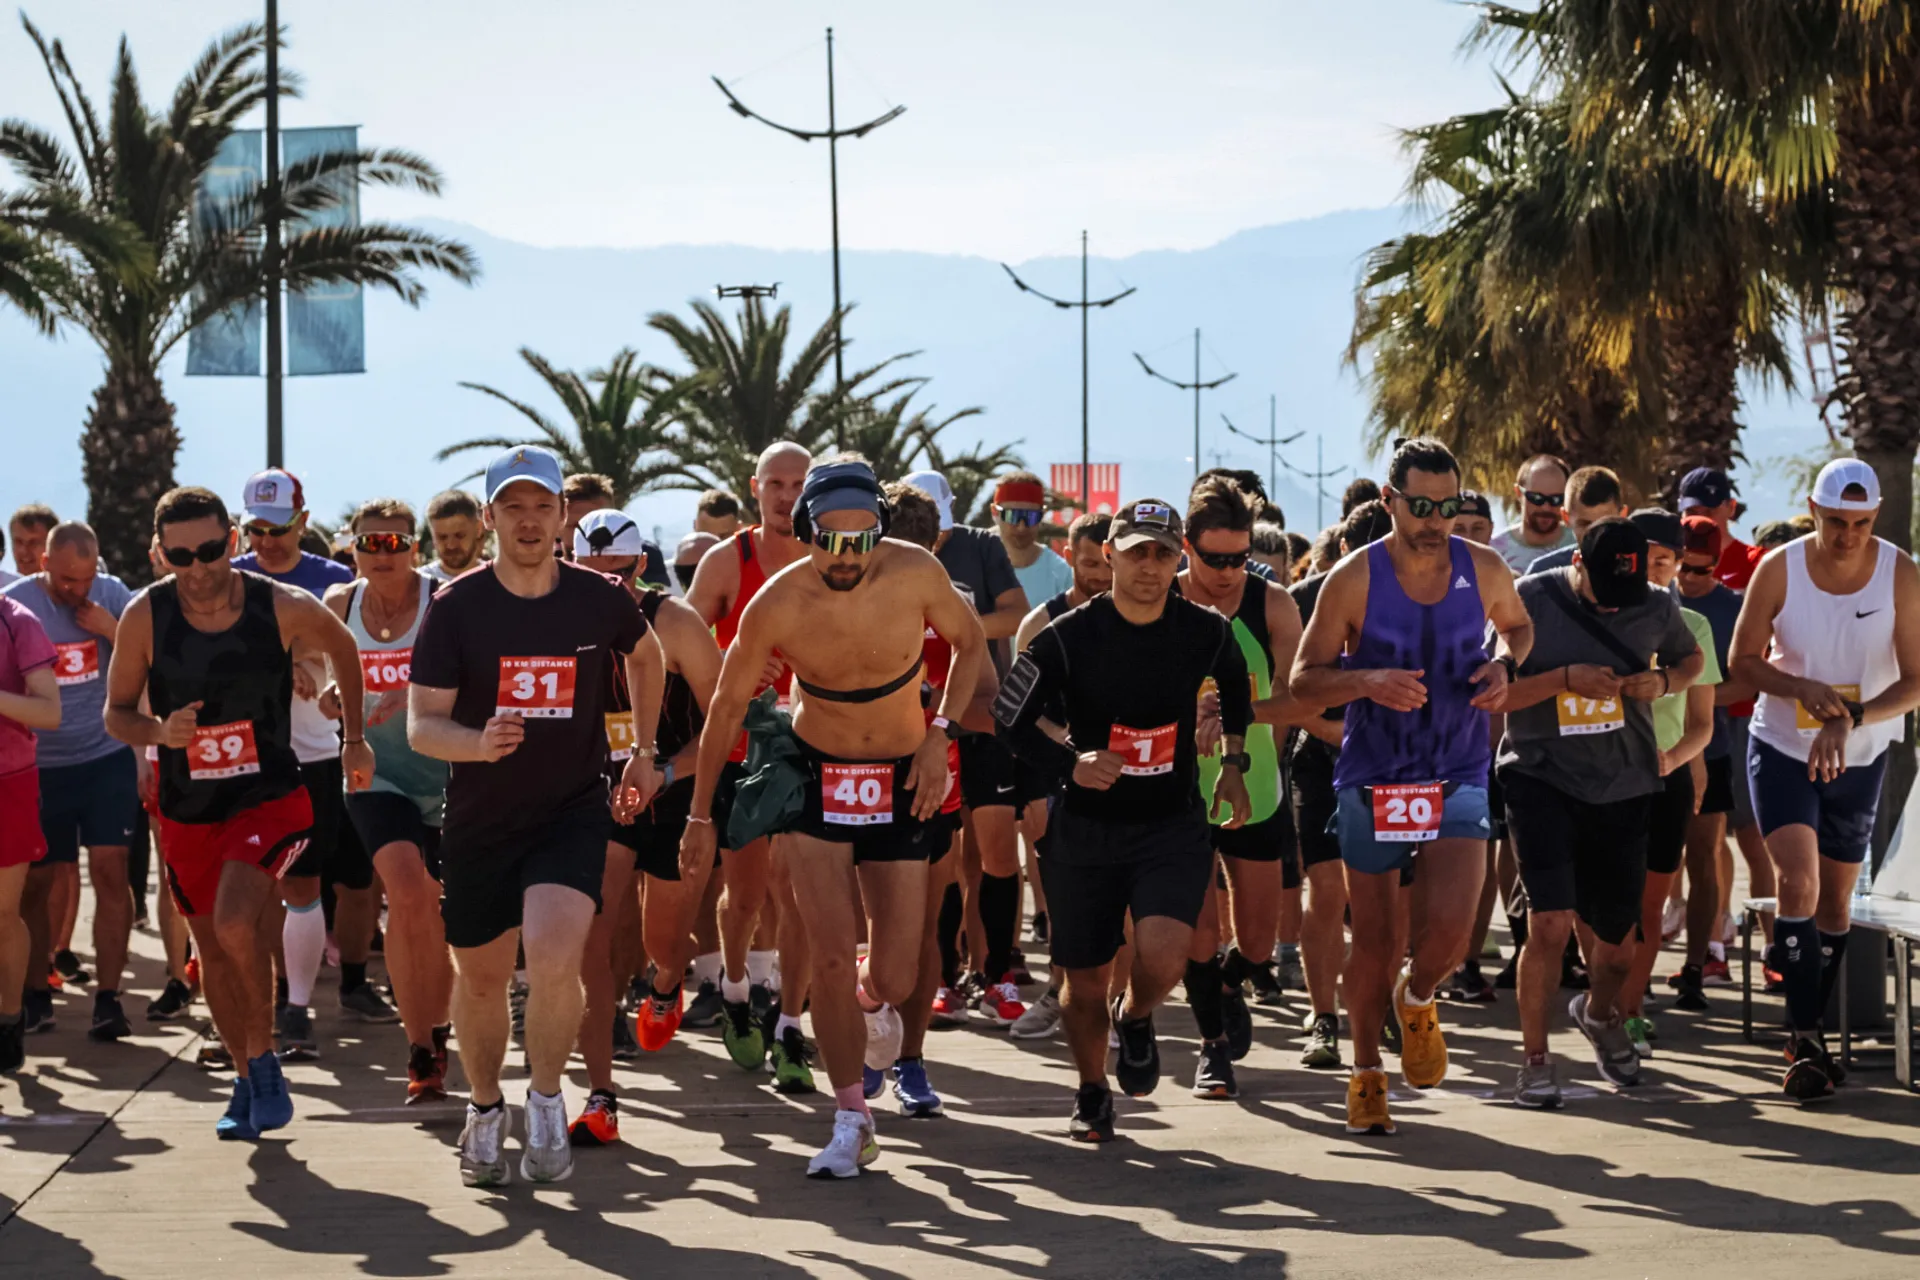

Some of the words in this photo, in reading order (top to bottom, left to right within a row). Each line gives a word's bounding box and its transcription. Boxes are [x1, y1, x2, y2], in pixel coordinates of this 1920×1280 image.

[65, 650, 84, 673] 3
[531, 660, 574, 668] DISTANCE
[367, 664, 411, 684] 100
[511, 671, 558, 700] 31
[211, 722, 250, 736] DISTANCE
[1139, 725, 1175, 738] DISTANCE
[198, 735, 244, 763] 39
[1132, 738, 1153, 763] 1
[825, 766, 834, 774] 10
[851, 767, 892, 775] DISTANCE
[833, 779, 882, 807] 40
[1375, 788, 1384, 796] 10
[1386, 788, 1399, 796] KM
[1401, 786, 1440, 796] DISTANCE
[1385, 797, 1433, 824] 20
